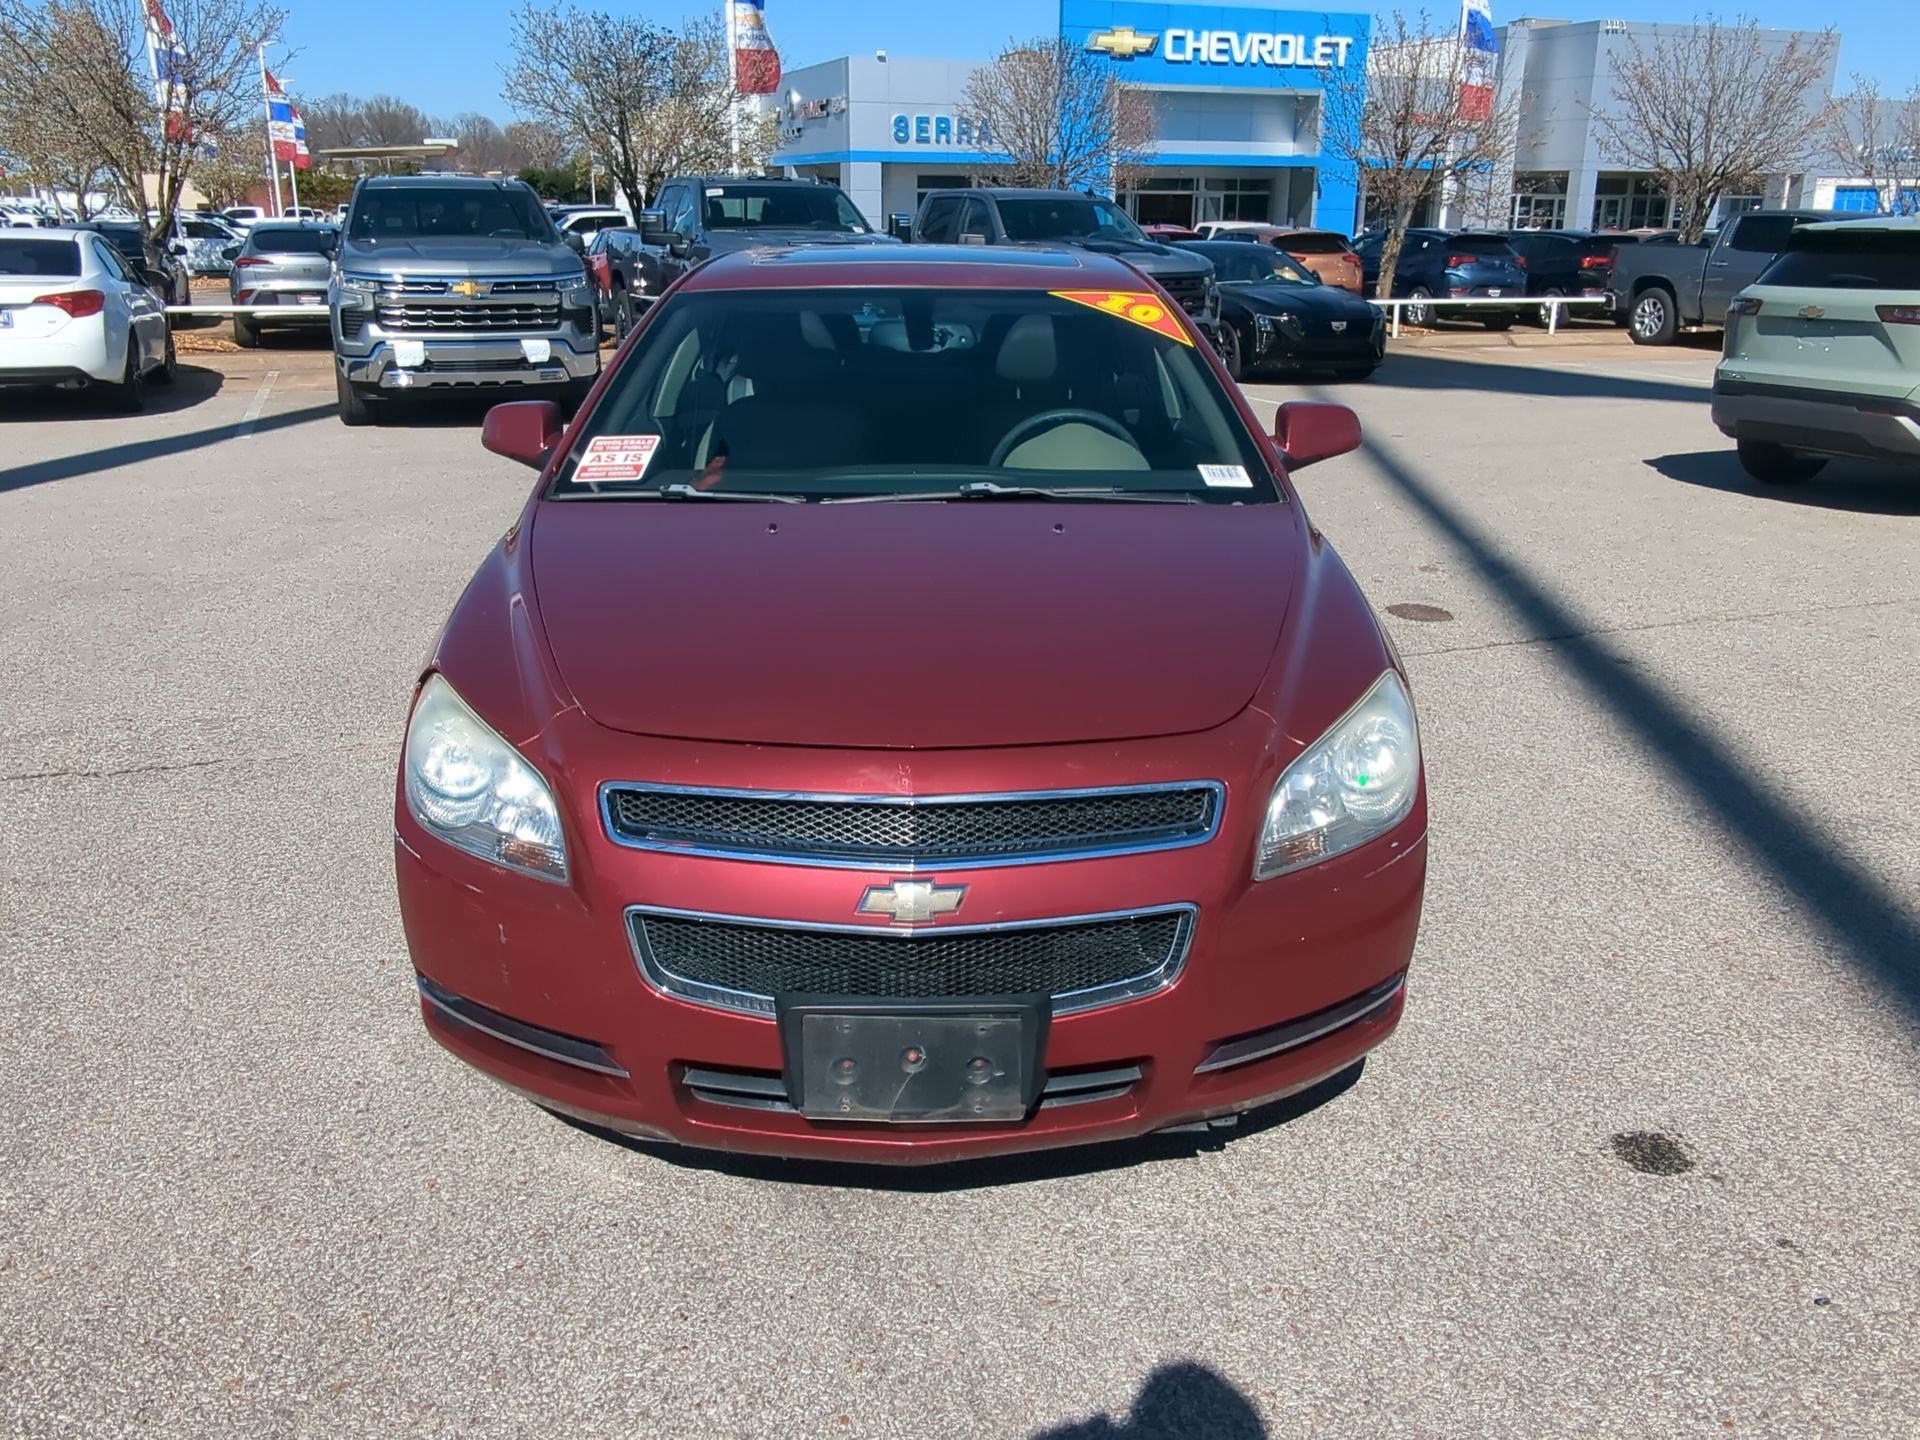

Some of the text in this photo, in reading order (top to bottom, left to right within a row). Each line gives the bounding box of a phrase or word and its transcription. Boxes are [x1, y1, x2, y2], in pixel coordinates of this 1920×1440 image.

[1164, 28, 1353, 68] CHEVROLET
[893, 114, 993, 145] SERRA
[1096, 294, 1164, 323] 10
[590, 453, 643, 463] AS IS
